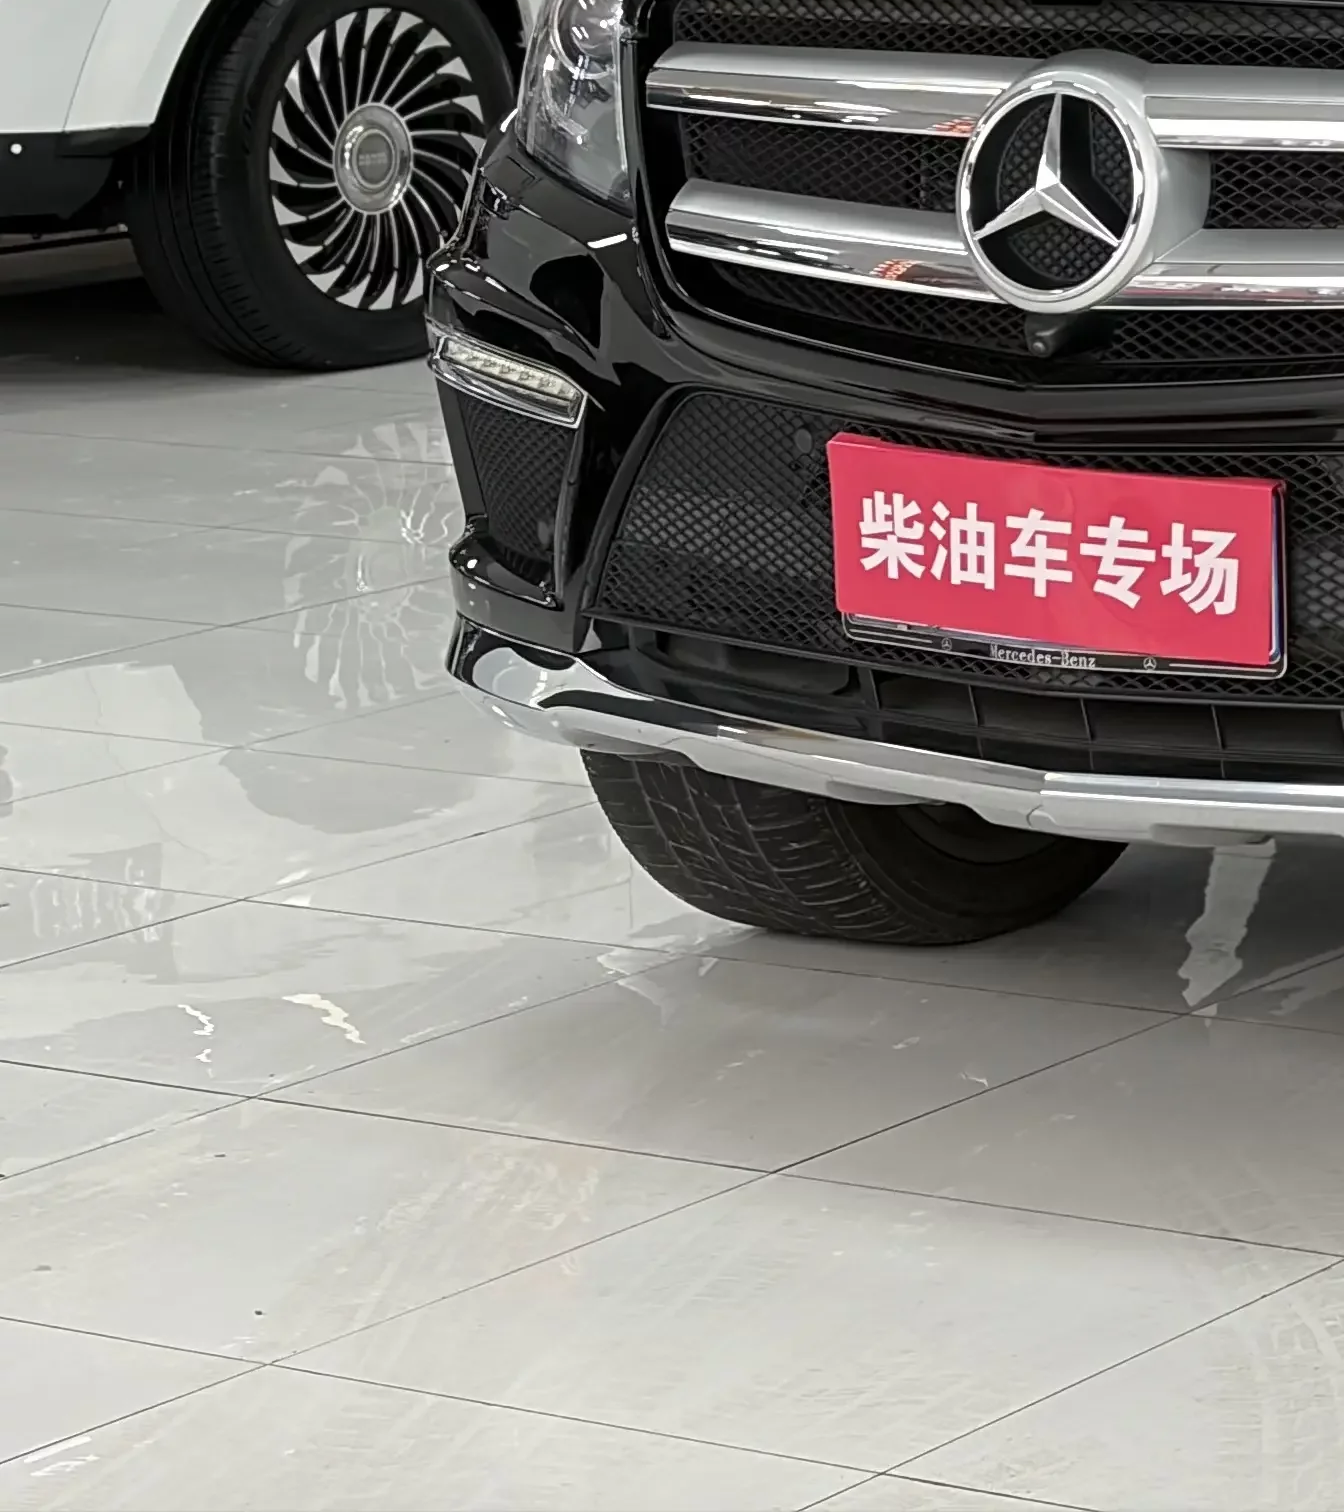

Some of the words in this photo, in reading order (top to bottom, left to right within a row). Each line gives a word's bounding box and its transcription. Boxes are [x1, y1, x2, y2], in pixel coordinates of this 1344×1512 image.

[859, 490, 1240, 615] 柴油车专场
[989, 642, 1097, 669] Mercedes-Benz
